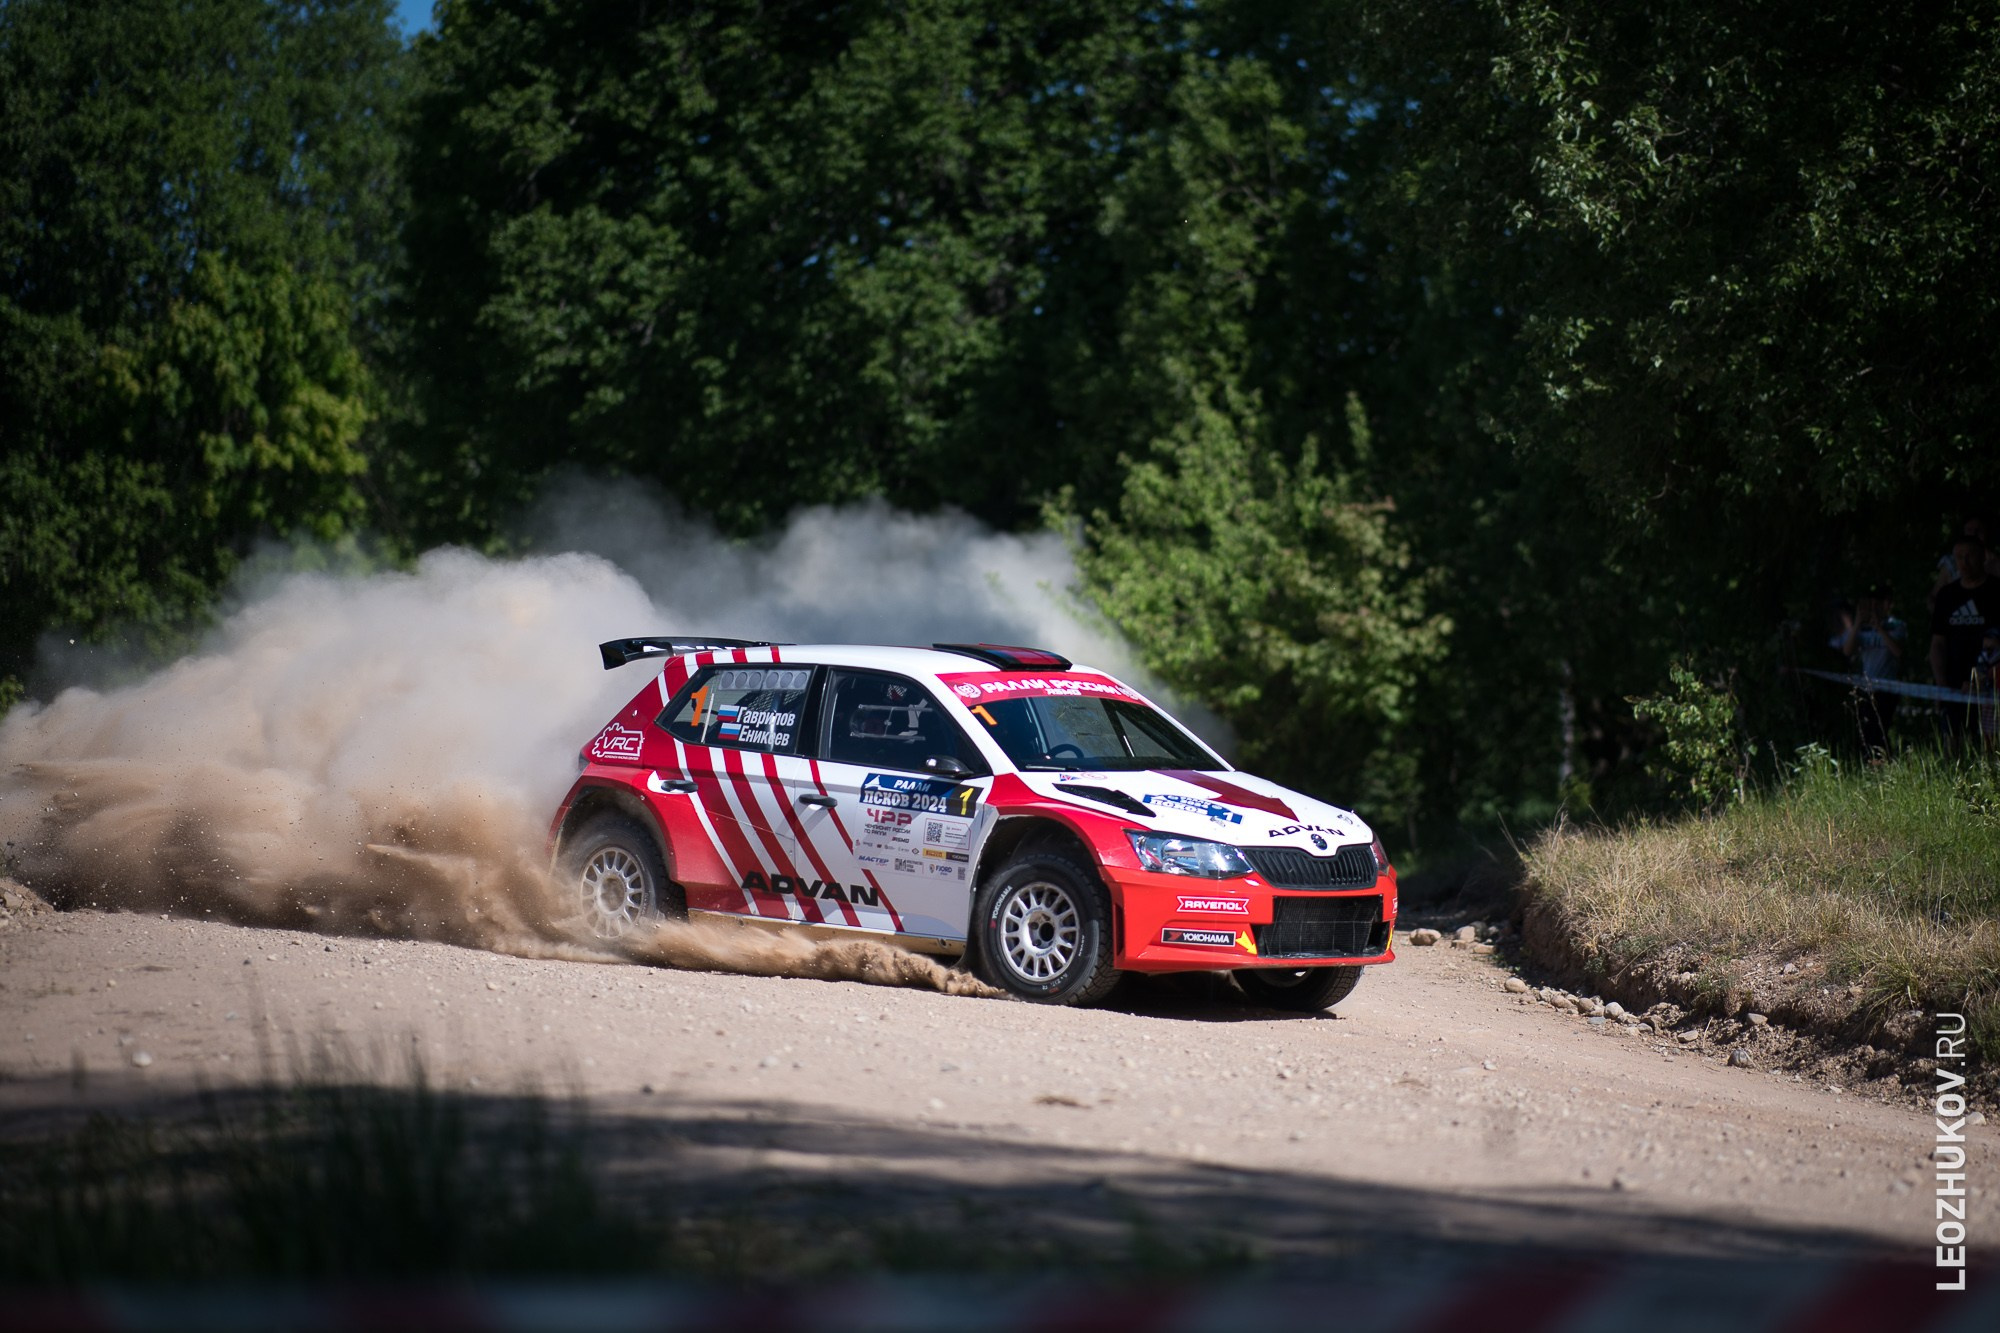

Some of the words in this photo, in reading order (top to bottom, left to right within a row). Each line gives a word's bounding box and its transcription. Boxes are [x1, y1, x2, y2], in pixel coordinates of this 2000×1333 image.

[1949, 616, 1985, 625] adidas
[981, 679, 1050, 693] РАЛЛИ
[691, 686, 709, 727] 1
[971, 705, 998, 726] 1
[737, 707, 796, 727] Гаврилов
[603, 736, 638, 751] VRC
[738, 726, 790, 747] Еникеев
[893, 780, 931, 792] РАЛЛИ
[863, 790, 910, 808] ПСКОВ
[912, 793, 947, 813] 2024
[960, 787, 974, 815] 1
[859, 855, 890, 864] МАСТЕР
[741, 871, 879, 907] ADVAN
[991, 885, 1013, 919] YOKOHAMA
[1184, 900, 1243, 911] RAVENOL
[1182, 932, 1230, 944] YOKOHAMA
